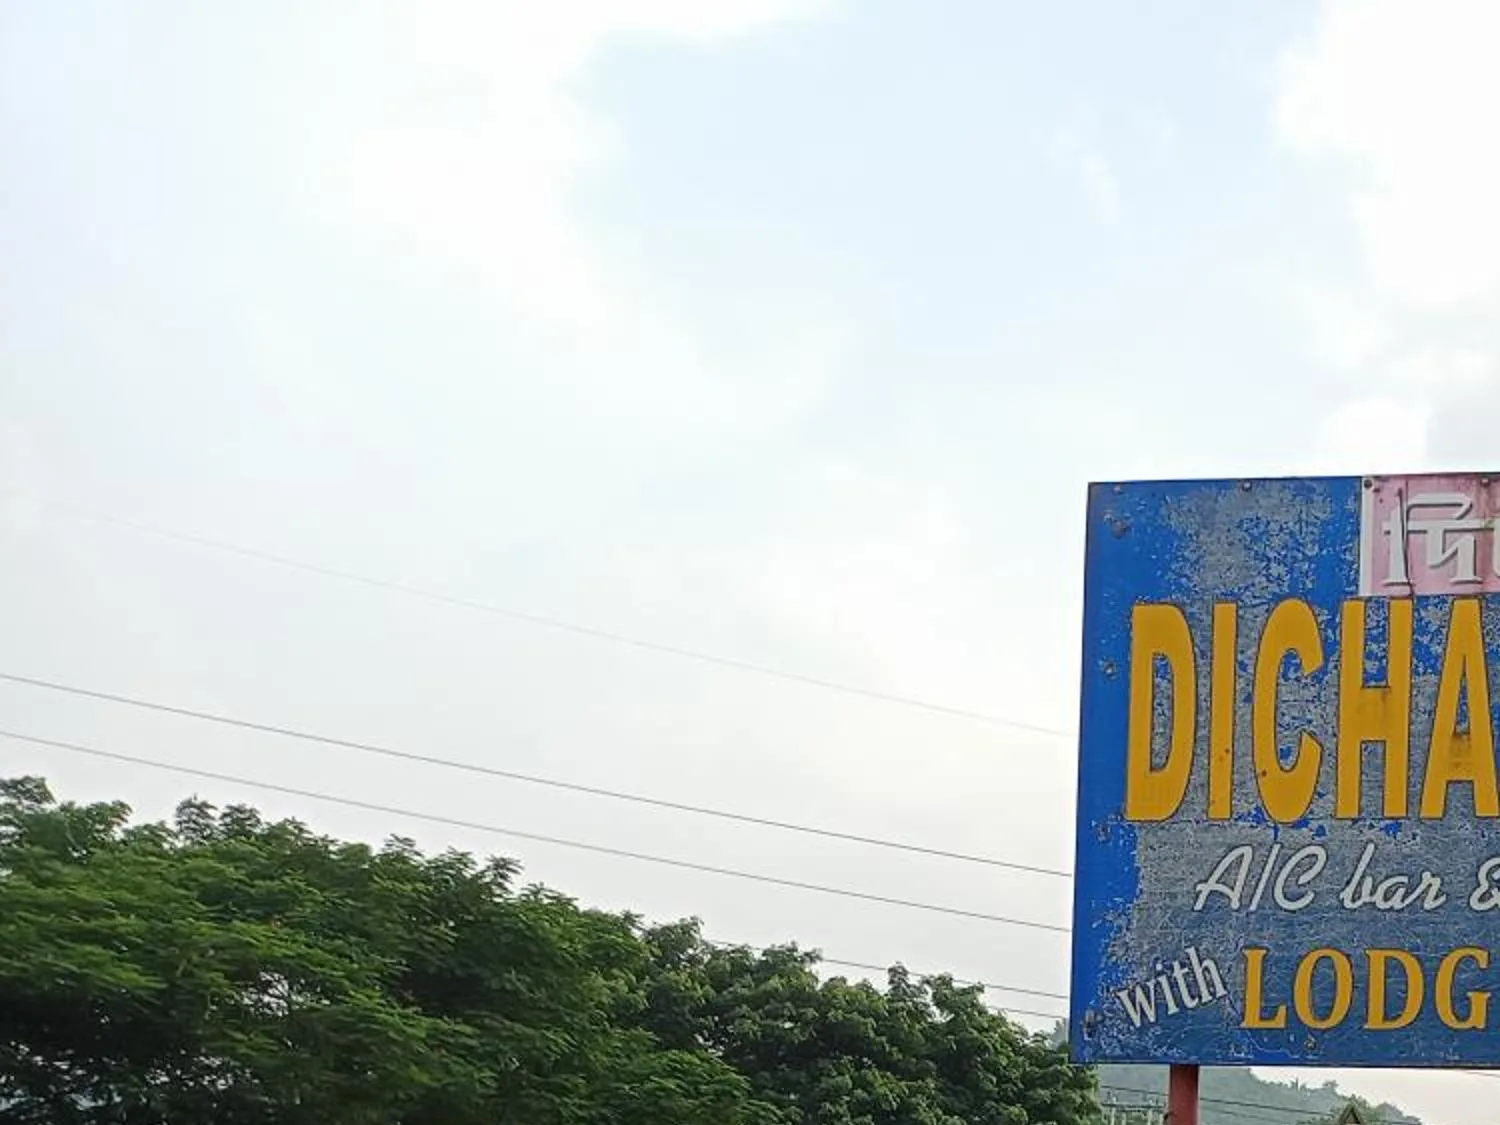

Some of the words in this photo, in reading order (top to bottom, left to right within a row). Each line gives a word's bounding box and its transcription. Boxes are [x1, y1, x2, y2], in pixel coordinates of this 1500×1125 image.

[1192, 841, 1328, 913] A/C
[1339, 843, 1447, 911] bar
[1114, 947, 1228, 1030] with
